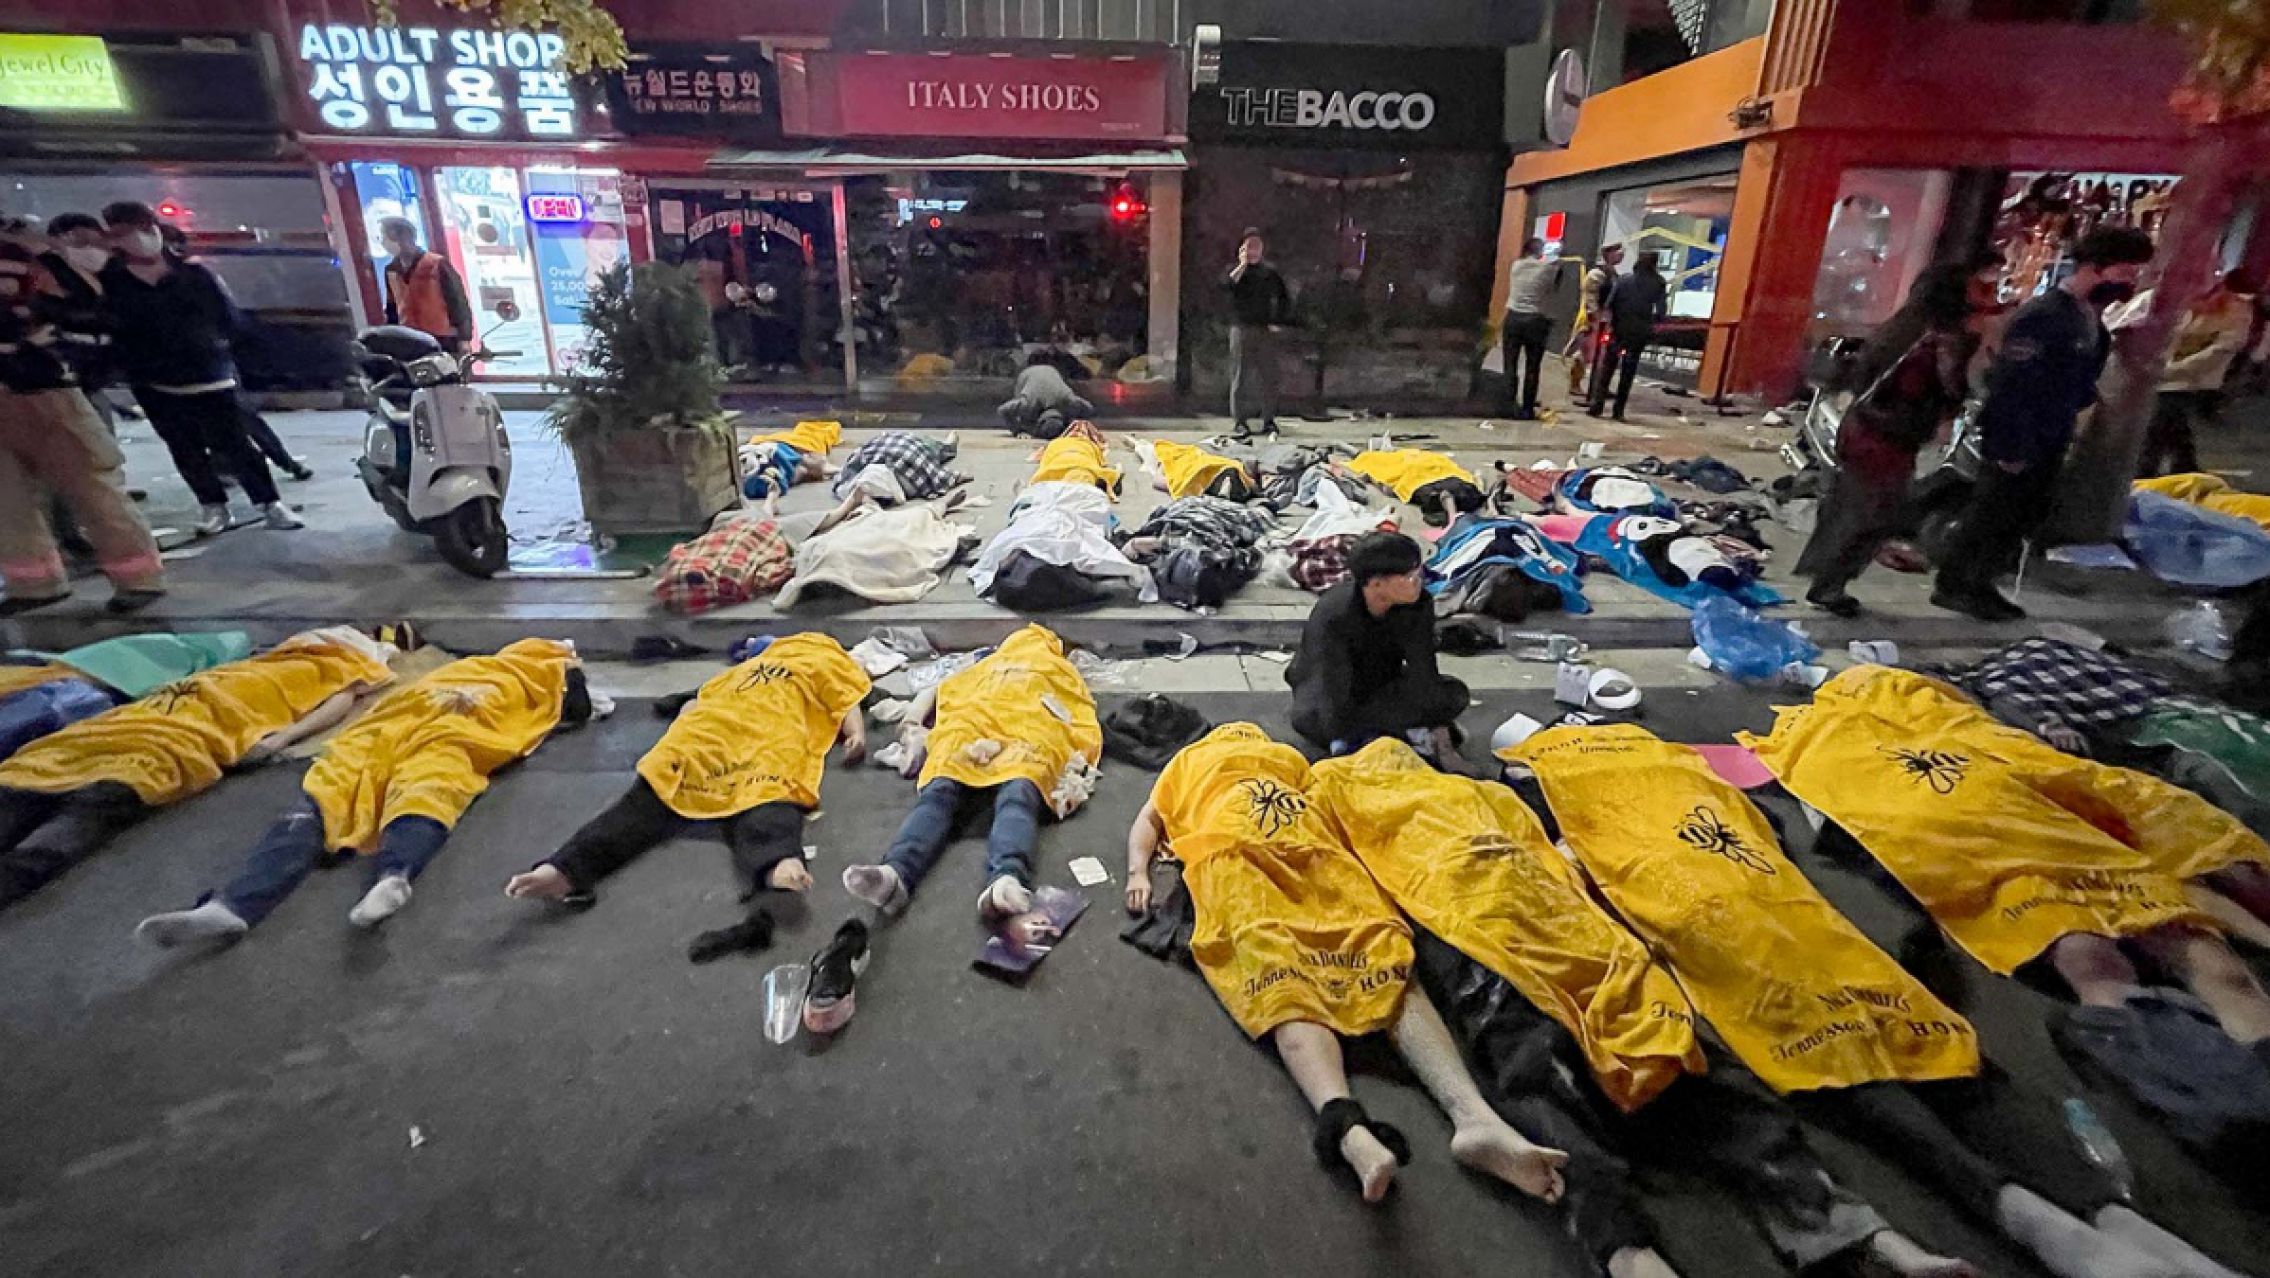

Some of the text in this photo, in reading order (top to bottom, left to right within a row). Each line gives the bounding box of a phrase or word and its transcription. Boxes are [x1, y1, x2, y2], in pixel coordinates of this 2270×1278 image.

[301, 24, 565, 67] ADULT SHOP
[308, 61, 574, 133] 성인용품
[908, 80, 1100, 112] ITALY SHOES
